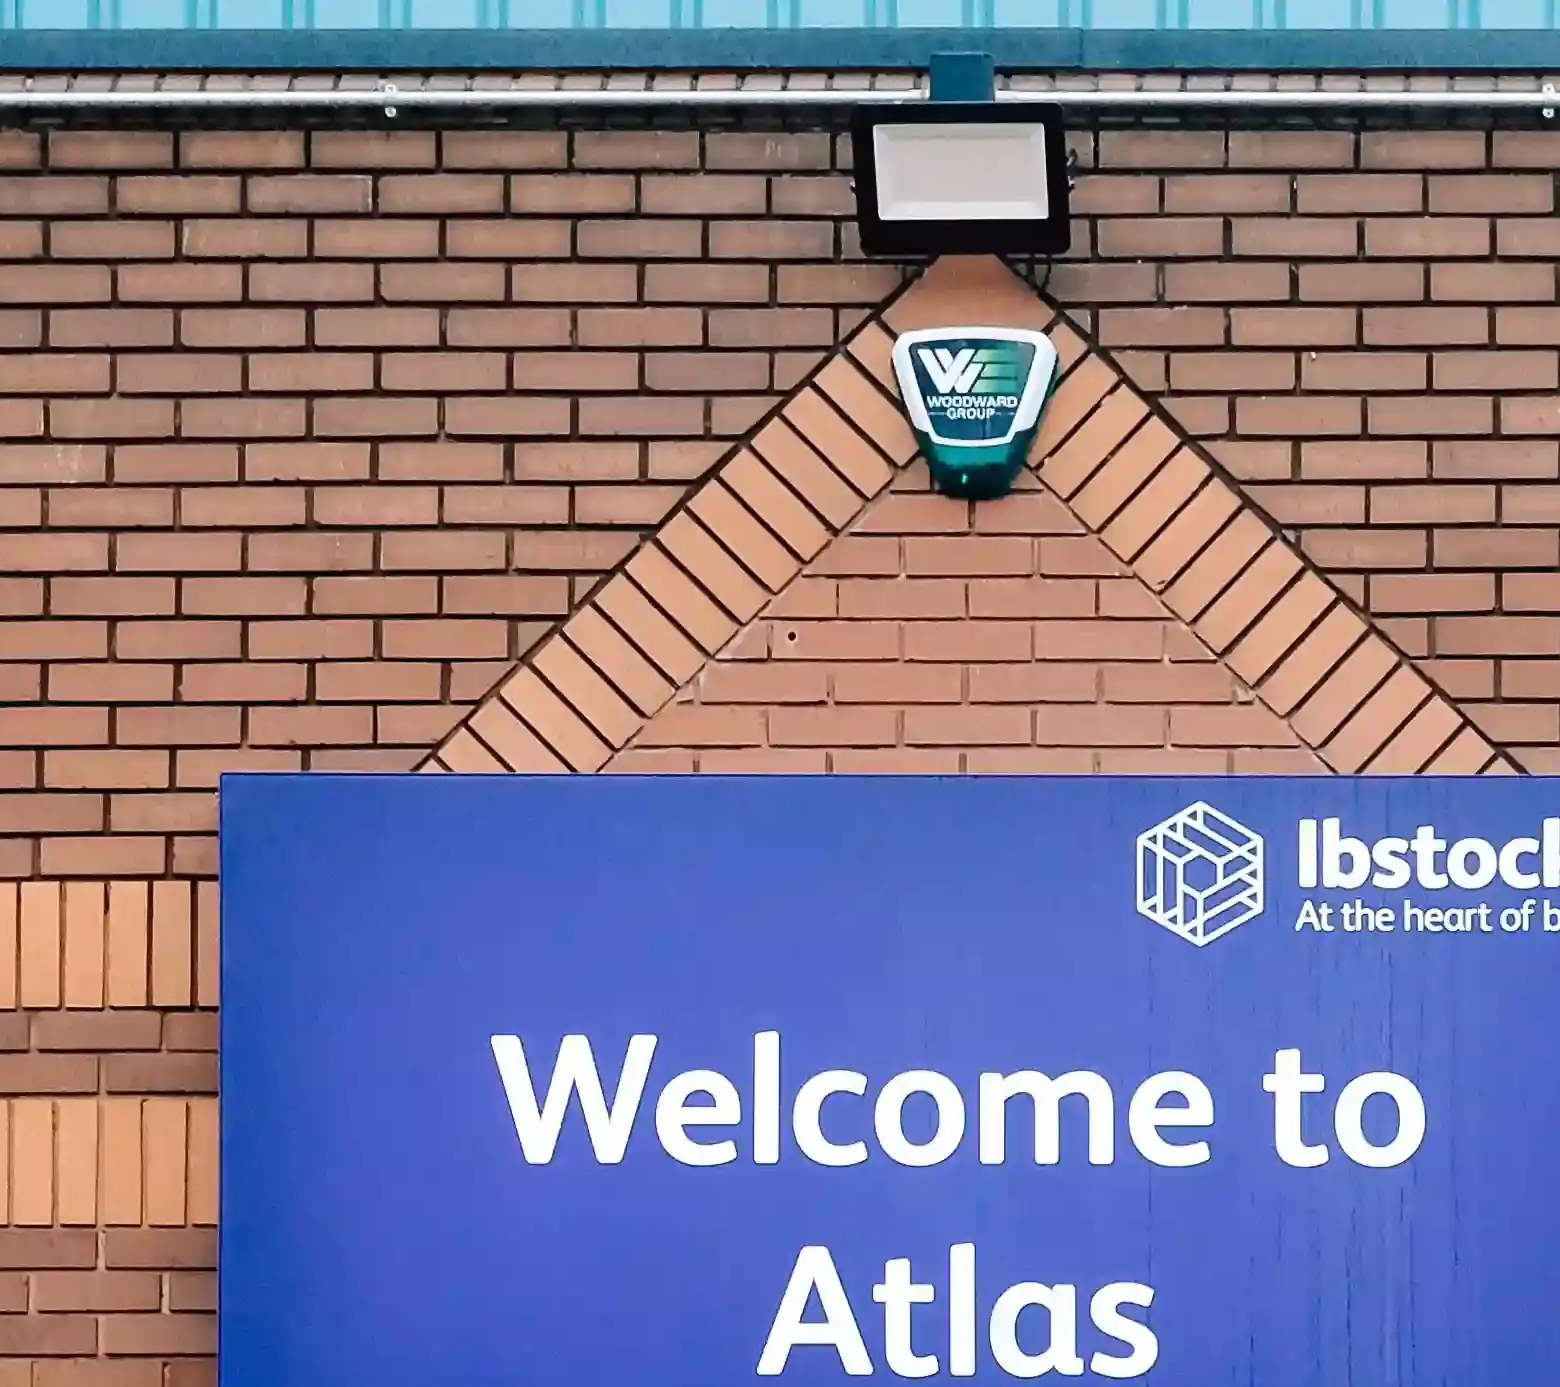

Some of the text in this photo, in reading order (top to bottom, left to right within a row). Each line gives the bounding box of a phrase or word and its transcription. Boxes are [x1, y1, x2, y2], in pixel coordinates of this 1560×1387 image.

[926, 395, 1018, 408] WOODWARD
[946, 408, 996, 420] GROUP
[1295, 899, 1335, 932] At
[1340, 899, 1396, 932] the
[1404, 899, 1493, 932] heart
[1499, 898, 1537, 932] of
[490, 1030, 1426, 1168] Welcome to
[756, 1242, 1158, 1378] Atlas
